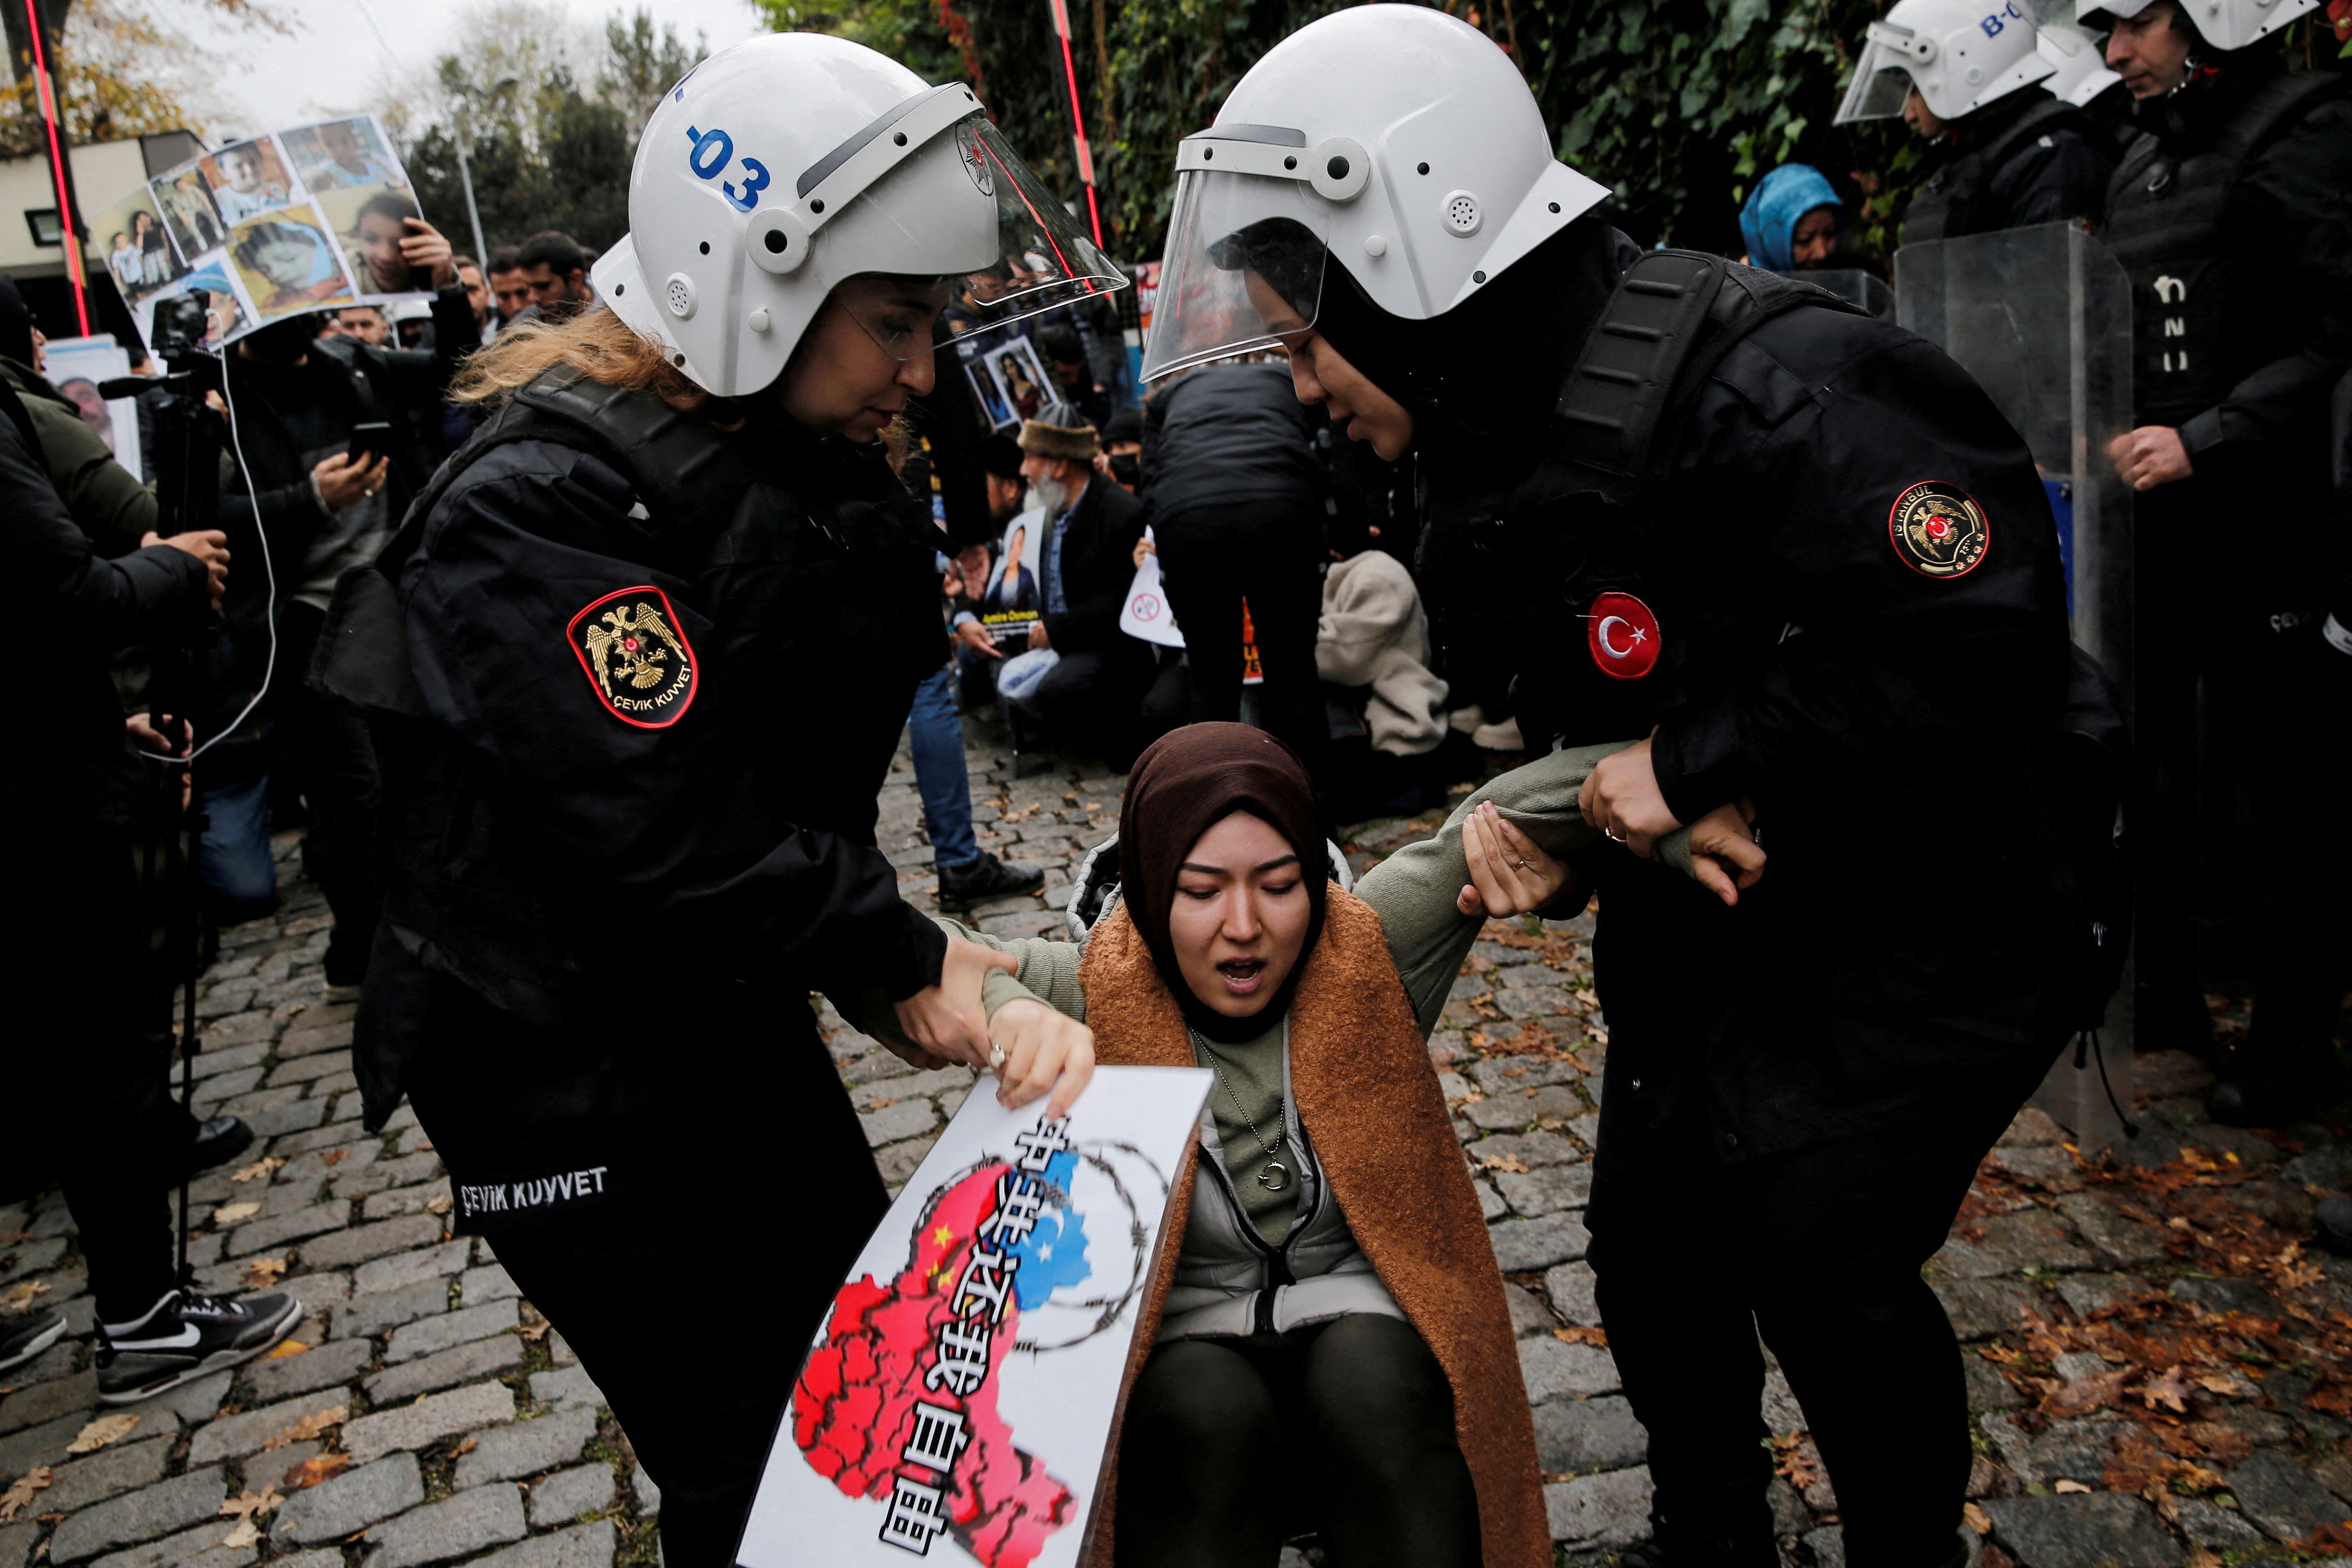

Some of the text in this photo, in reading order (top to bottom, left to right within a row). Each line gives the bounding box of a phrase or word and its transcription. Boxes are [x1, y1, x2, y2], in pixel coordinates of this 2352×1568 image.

[656, 665, 692, 707] KUVVET
[513, 1166, 608, 1209] KUVVET
[879, 1114, 1073, 1556] 中共还我自由
